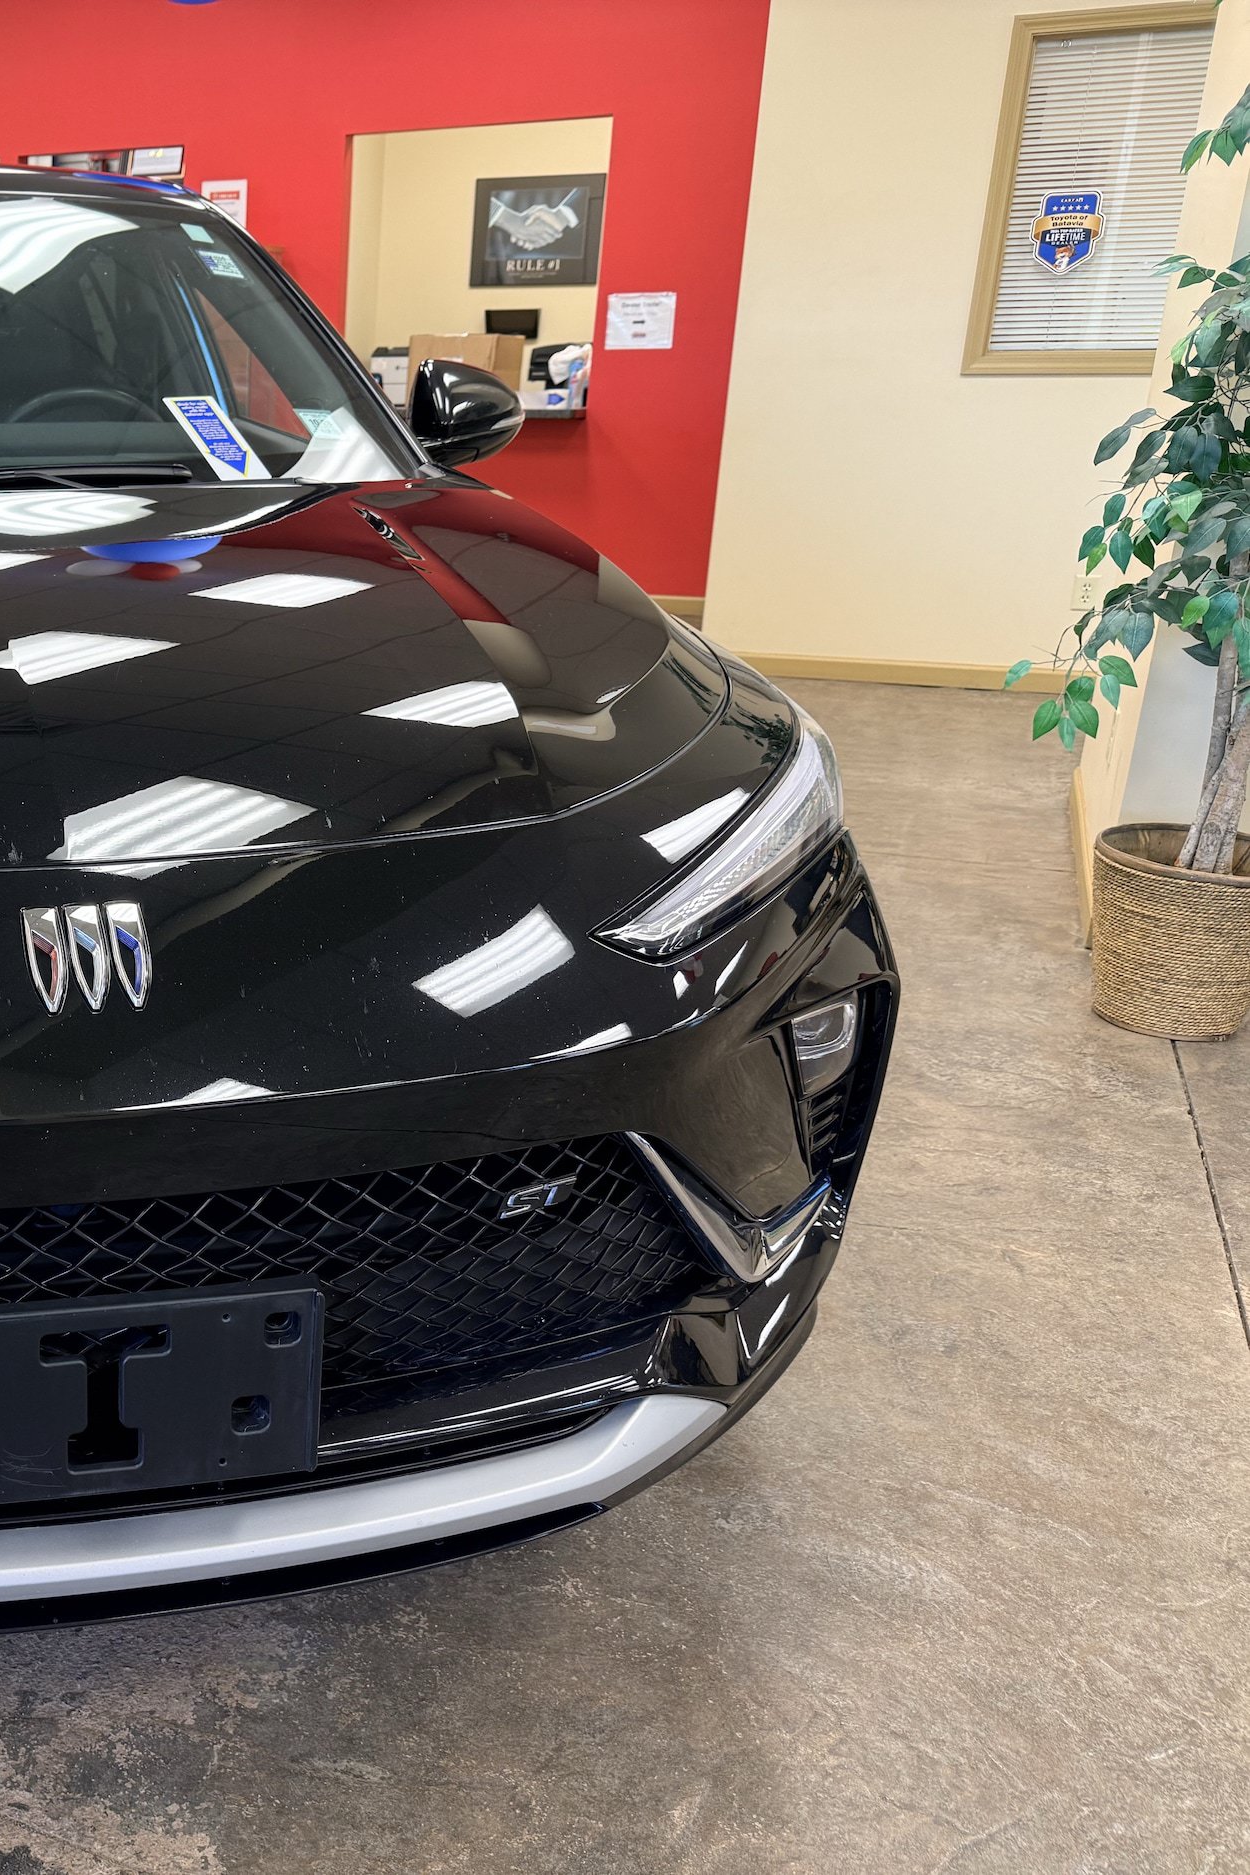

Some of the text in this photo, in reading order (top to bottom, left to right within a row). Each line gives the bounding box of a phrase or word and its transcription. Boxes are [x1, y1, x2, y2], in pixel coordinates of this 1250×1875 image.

[1046, 232, 1086, 241] LIFETIME
[506, 259, 561, 272] RULE #1
[500, 1175, 577, 1219] ST
